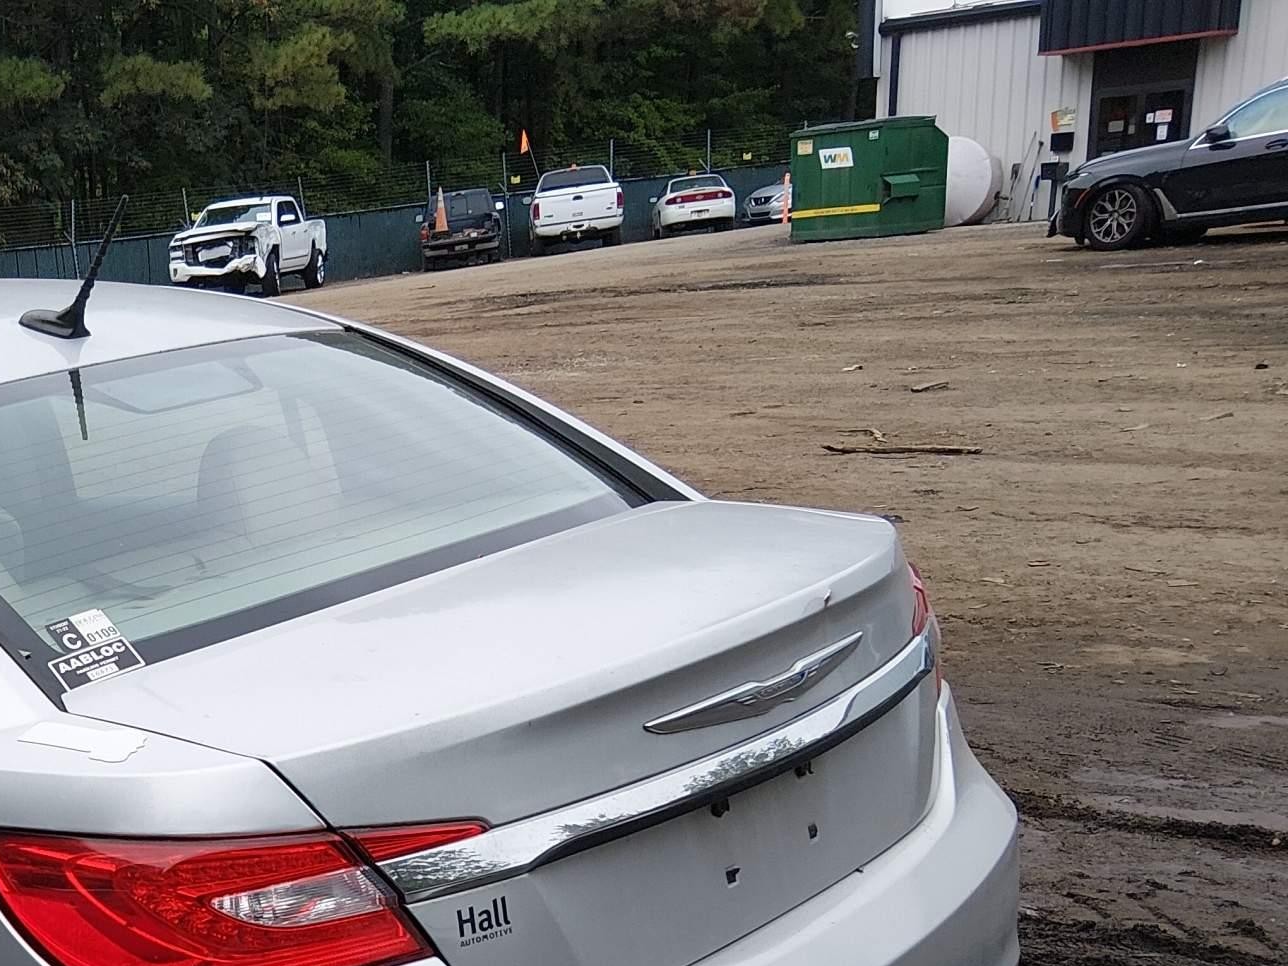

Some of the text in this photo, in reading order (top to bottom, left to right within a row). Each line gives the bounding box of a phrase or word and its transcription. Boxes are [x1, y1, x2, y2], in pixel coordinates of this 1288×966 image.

[823, 152, 850, 164] WM
[62, 633, 82, 650] C
[86, 626, 118, 642] 0109
[58, 642, 126, 674] AABLOC
[456, 896, 511, 938] Hall
